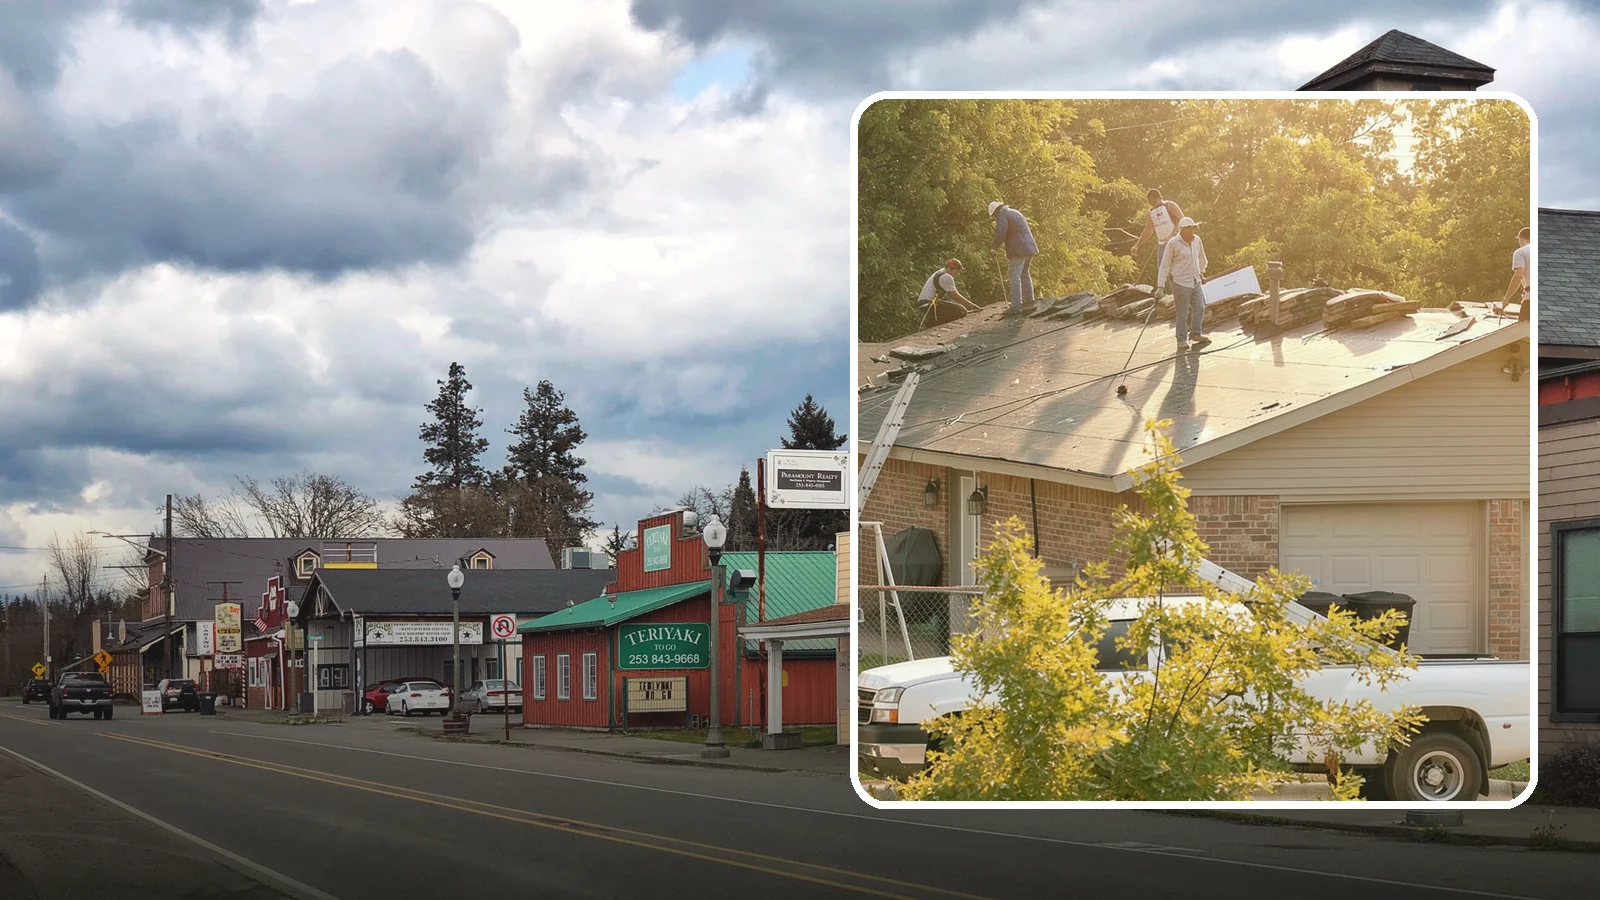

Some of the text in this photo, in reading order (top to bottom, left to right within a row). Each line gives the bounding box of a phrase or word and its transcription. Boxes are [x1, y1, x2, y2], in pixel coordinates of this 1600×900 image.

[625, 627, 702, 646] TERIYAKI
[654, 643, 677, 651] TO GO
[628, 653, 700, 665] 253 843-9668
